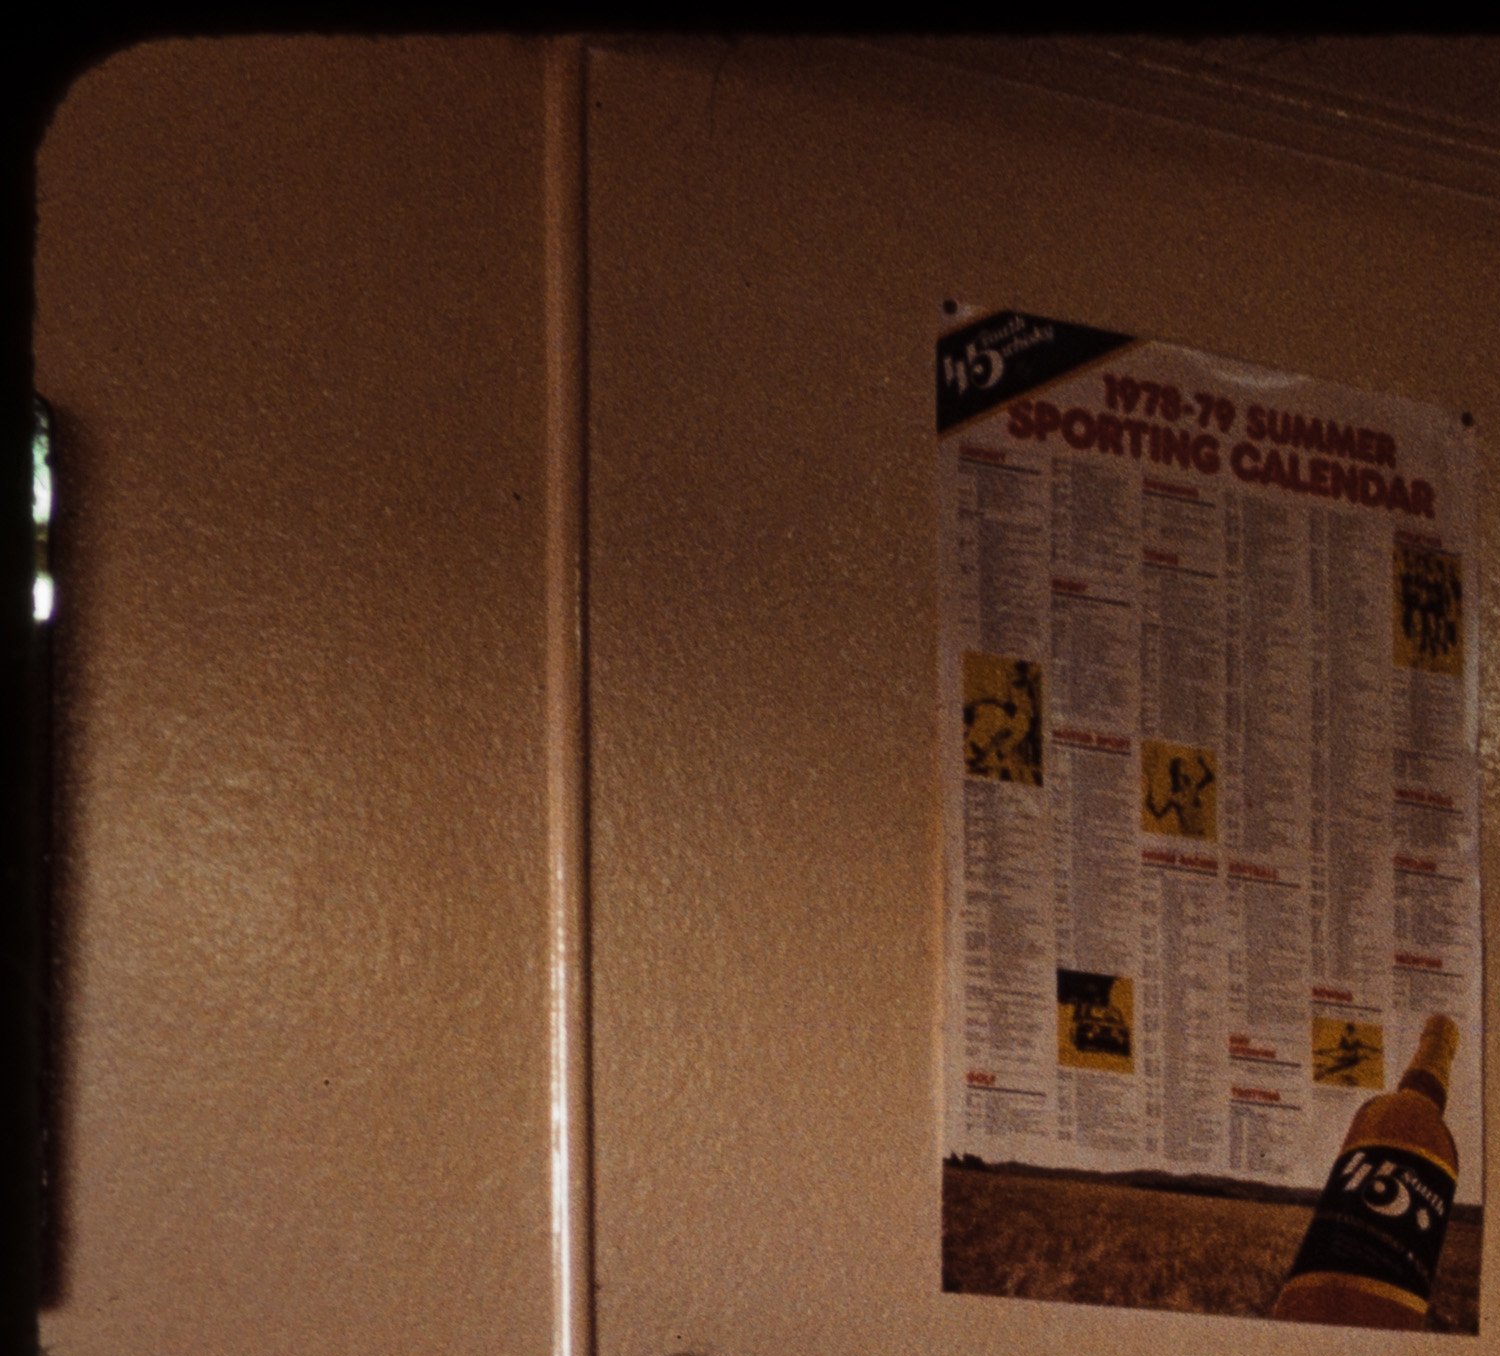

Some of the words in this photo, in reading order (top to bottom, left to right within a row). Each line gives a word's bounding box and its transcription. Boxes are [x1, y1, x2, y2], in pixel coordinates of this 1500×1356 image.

[1006, 401, 1222, 476] SPORTING
[1230, 441, 1437, 519] CALENDAR
[1102, 373, 1237, 432] 1978-79
[1245, 404, 1398, 469] SUMMER
